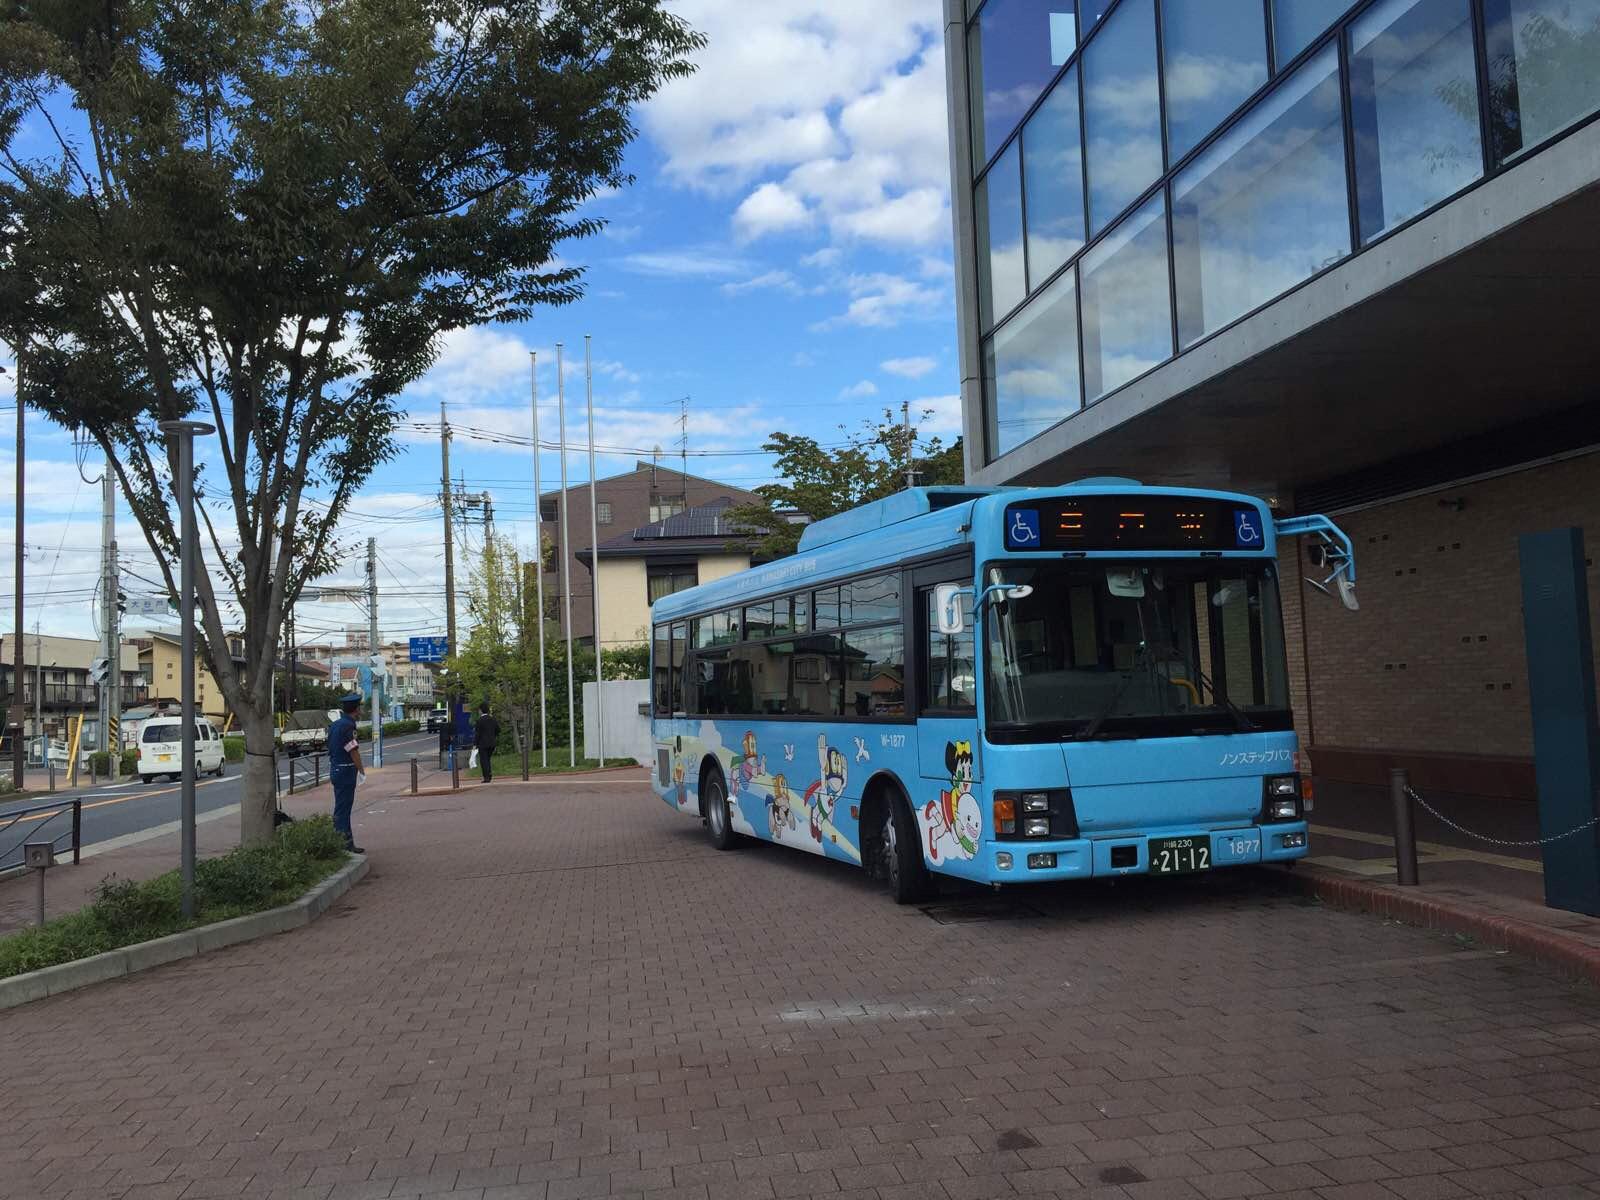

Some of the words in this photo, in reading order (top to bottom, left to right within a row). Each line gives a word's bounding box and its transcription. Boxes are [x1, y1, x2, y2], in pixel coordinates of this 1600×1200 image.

[880, 733, 906, 748] W-1877
[1219, 750, 1291, 766] ノンステップバス
[1230, 840, 1260, 855] 1877
[1160, 847, 1209, 872] 21-12
